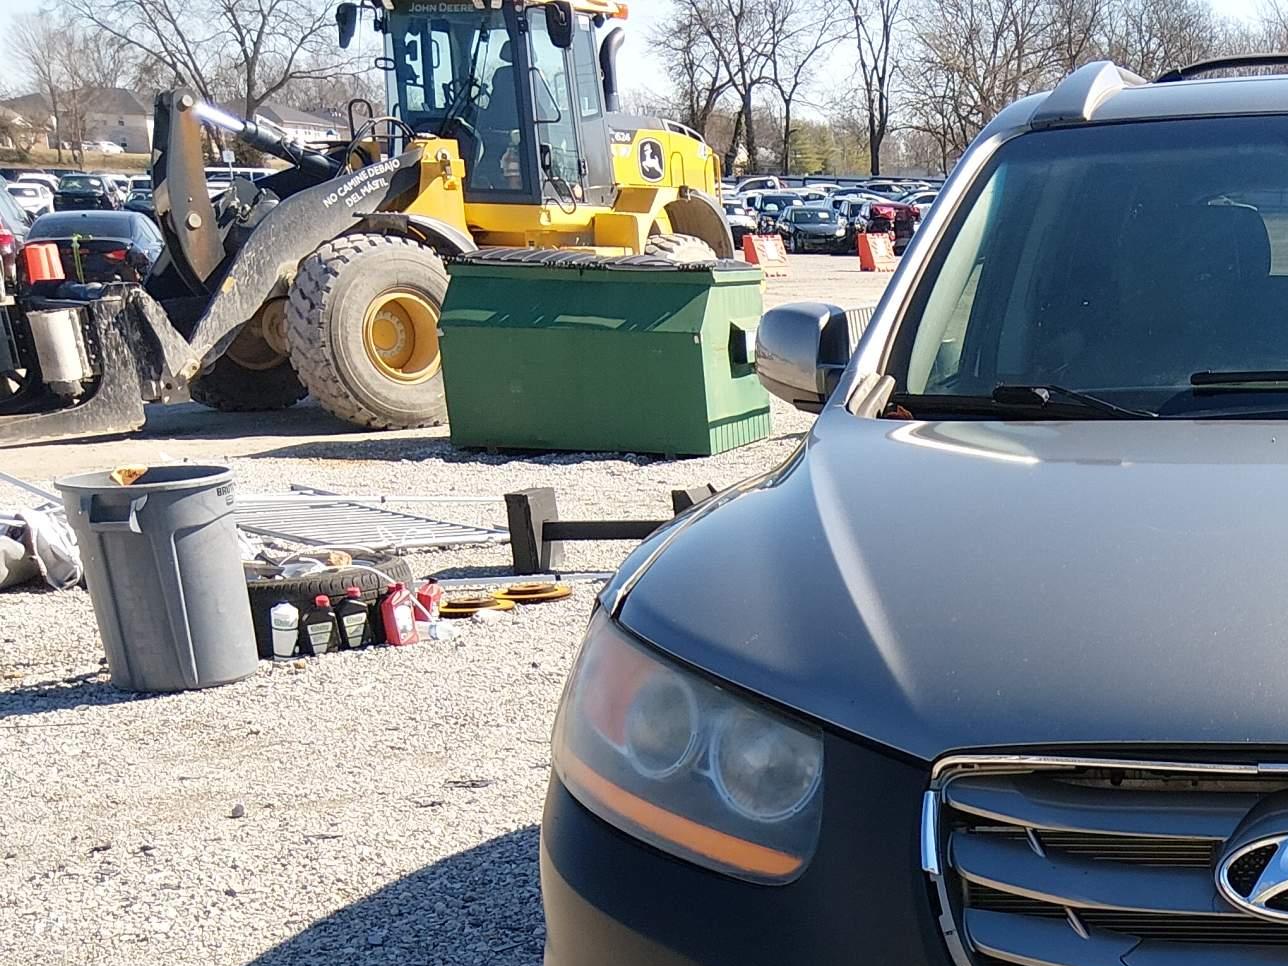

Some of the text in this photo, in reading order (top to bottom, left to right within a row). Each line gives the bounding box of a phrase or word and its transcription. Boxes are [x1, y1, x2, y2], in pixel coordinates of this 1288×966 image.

[408, 2, 475, 12] JOHN DEERE
[322, 158, 401, 208] NO CAMINE DEBAJO
[345, 177, 389, 208] DEL MÁSTIL
